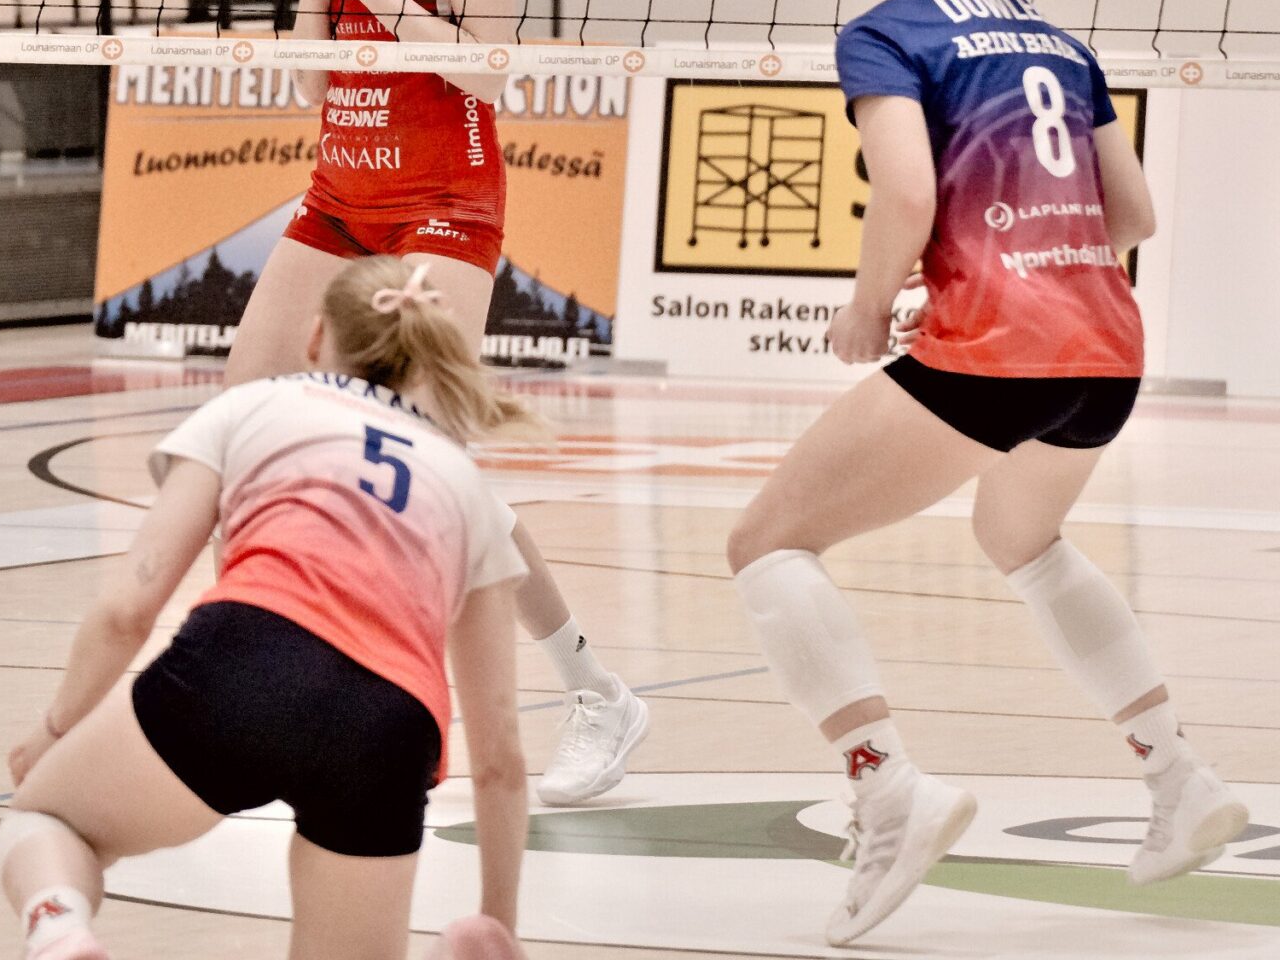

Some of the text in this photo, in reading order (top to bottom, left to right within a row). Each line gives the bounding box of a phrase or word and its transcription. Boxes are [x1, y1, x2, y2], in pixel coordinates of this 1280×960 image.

[21, 43, 99, 53] Lounaismaan OP
[150, 45, 230, 56] Lounaismaan OP
[273, 49, 353, 60] Lounaismaan OP
[404, 53, 484, 63] Lounaismaan OP
[538, 55, 619, 66] Lounaismaan OP
[673, 58, 756, 69] Lounaismaan OP
[1160, 68, 1176, 77] OP
[1022, 65, 1077, 178] 8
[461, 91, 484, 167] tiimipo
[416, 226, 460, 239] CRAFT
[651, 295, 730, 320] Salon
[359, 424, 414, 514] 5
